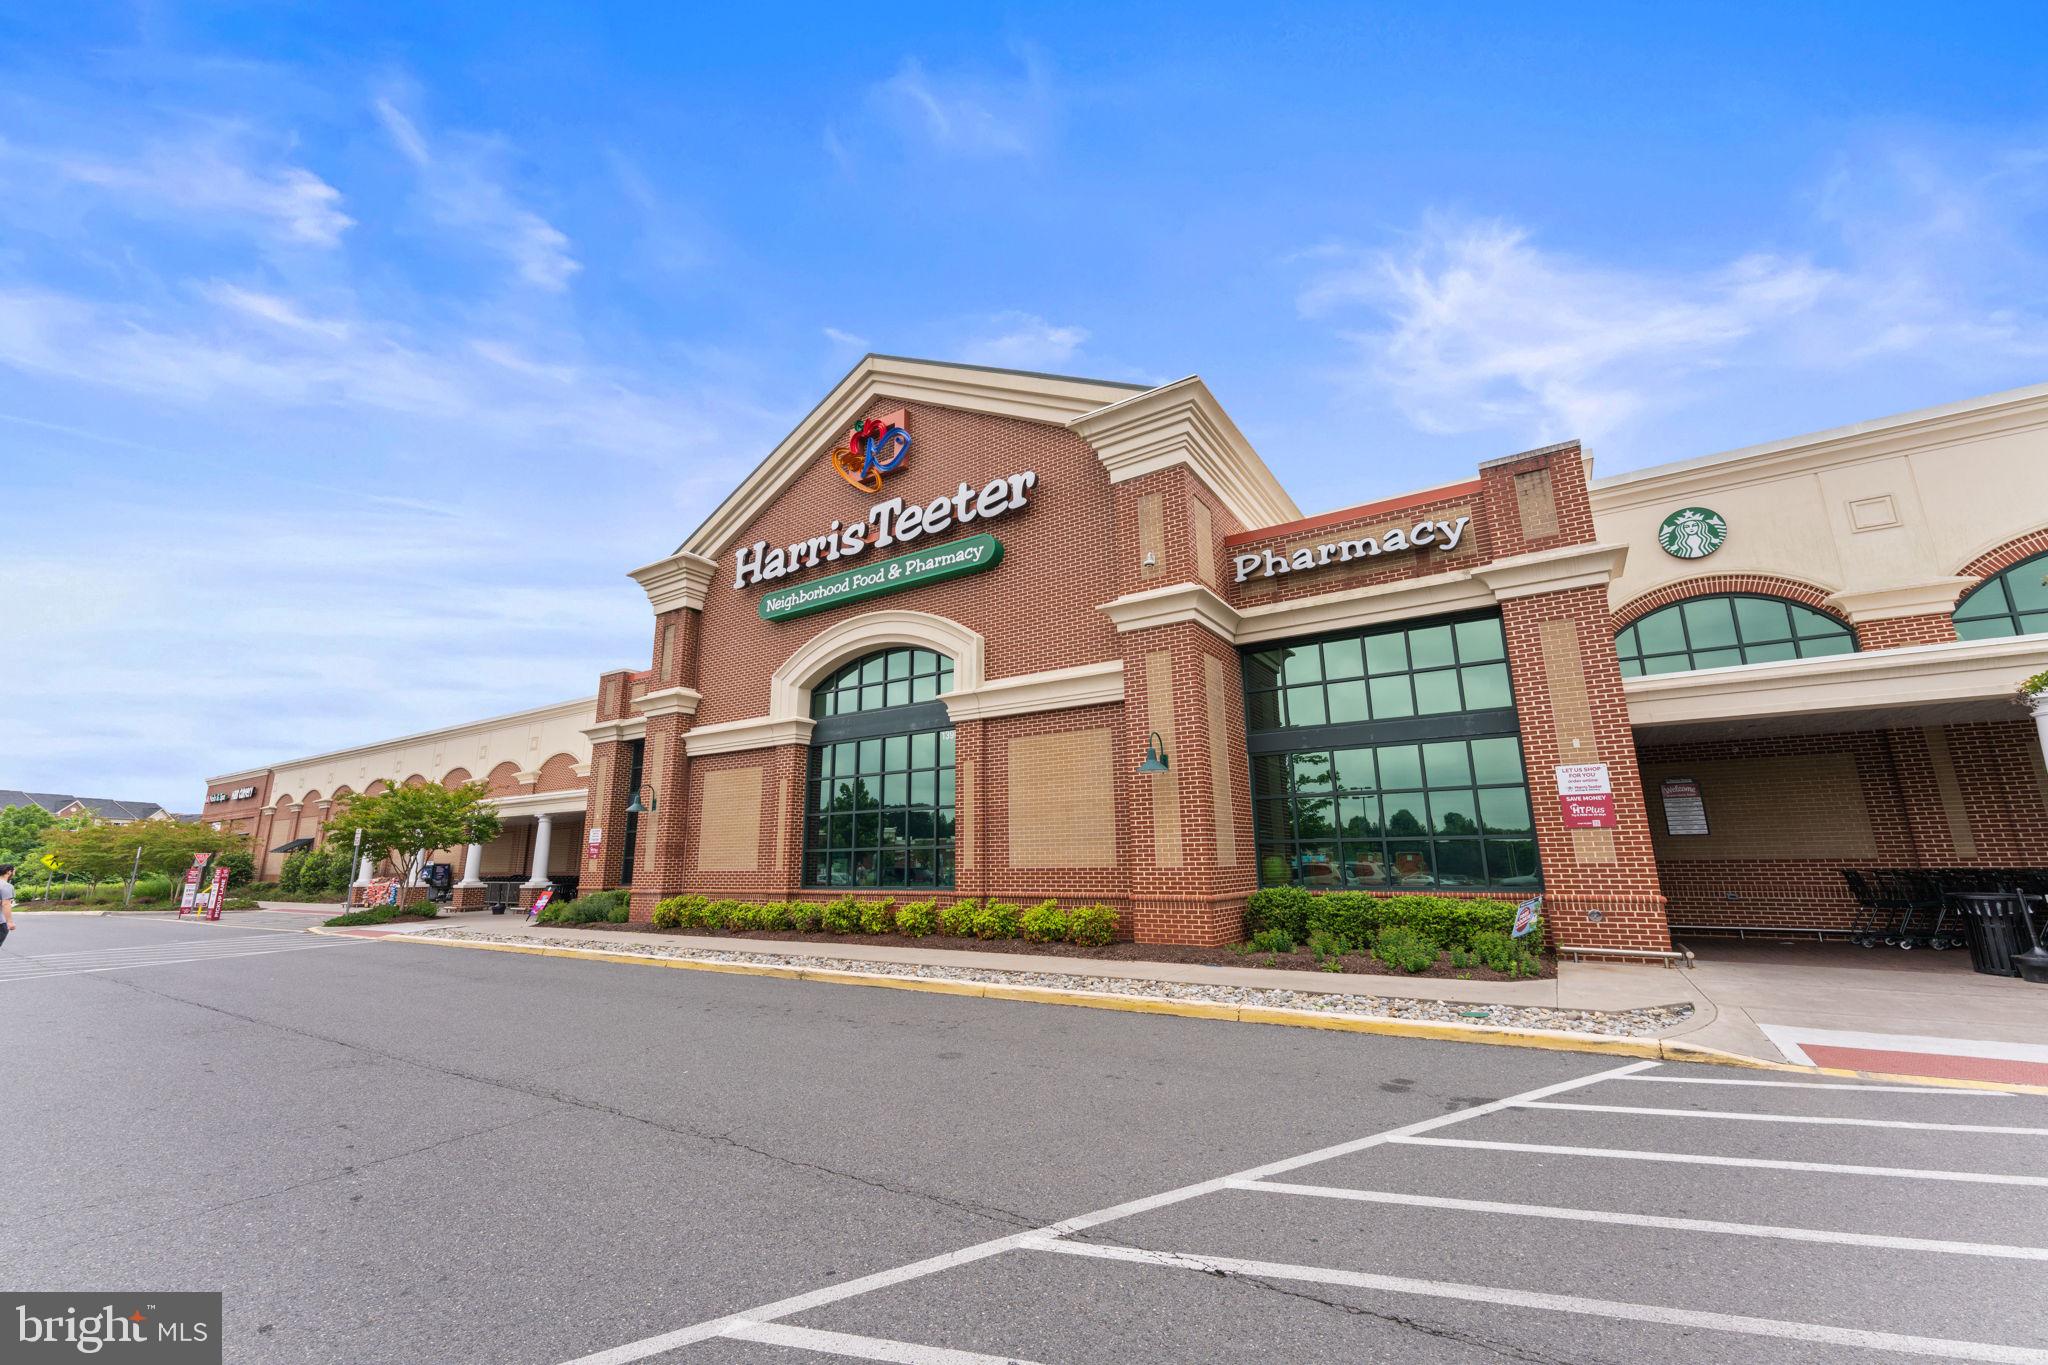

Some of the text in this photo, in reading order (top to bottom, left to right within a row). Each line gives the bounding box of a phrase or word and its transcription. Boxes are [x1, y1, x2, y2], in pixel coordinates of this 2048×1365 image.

[733, 470, 1037, 589] Harris Teeter
[1234, 517, 1470, 583] Pharmacy
[765, 544, 984, 613] Neighborhood Food & Pharmacy
[1663, 784, 1697, 794] Welcome
[1586, 806, 1605, 814] Plus
[218, 878, 227, 895] LANE
[214, 895, 223, 918] PICKUP
